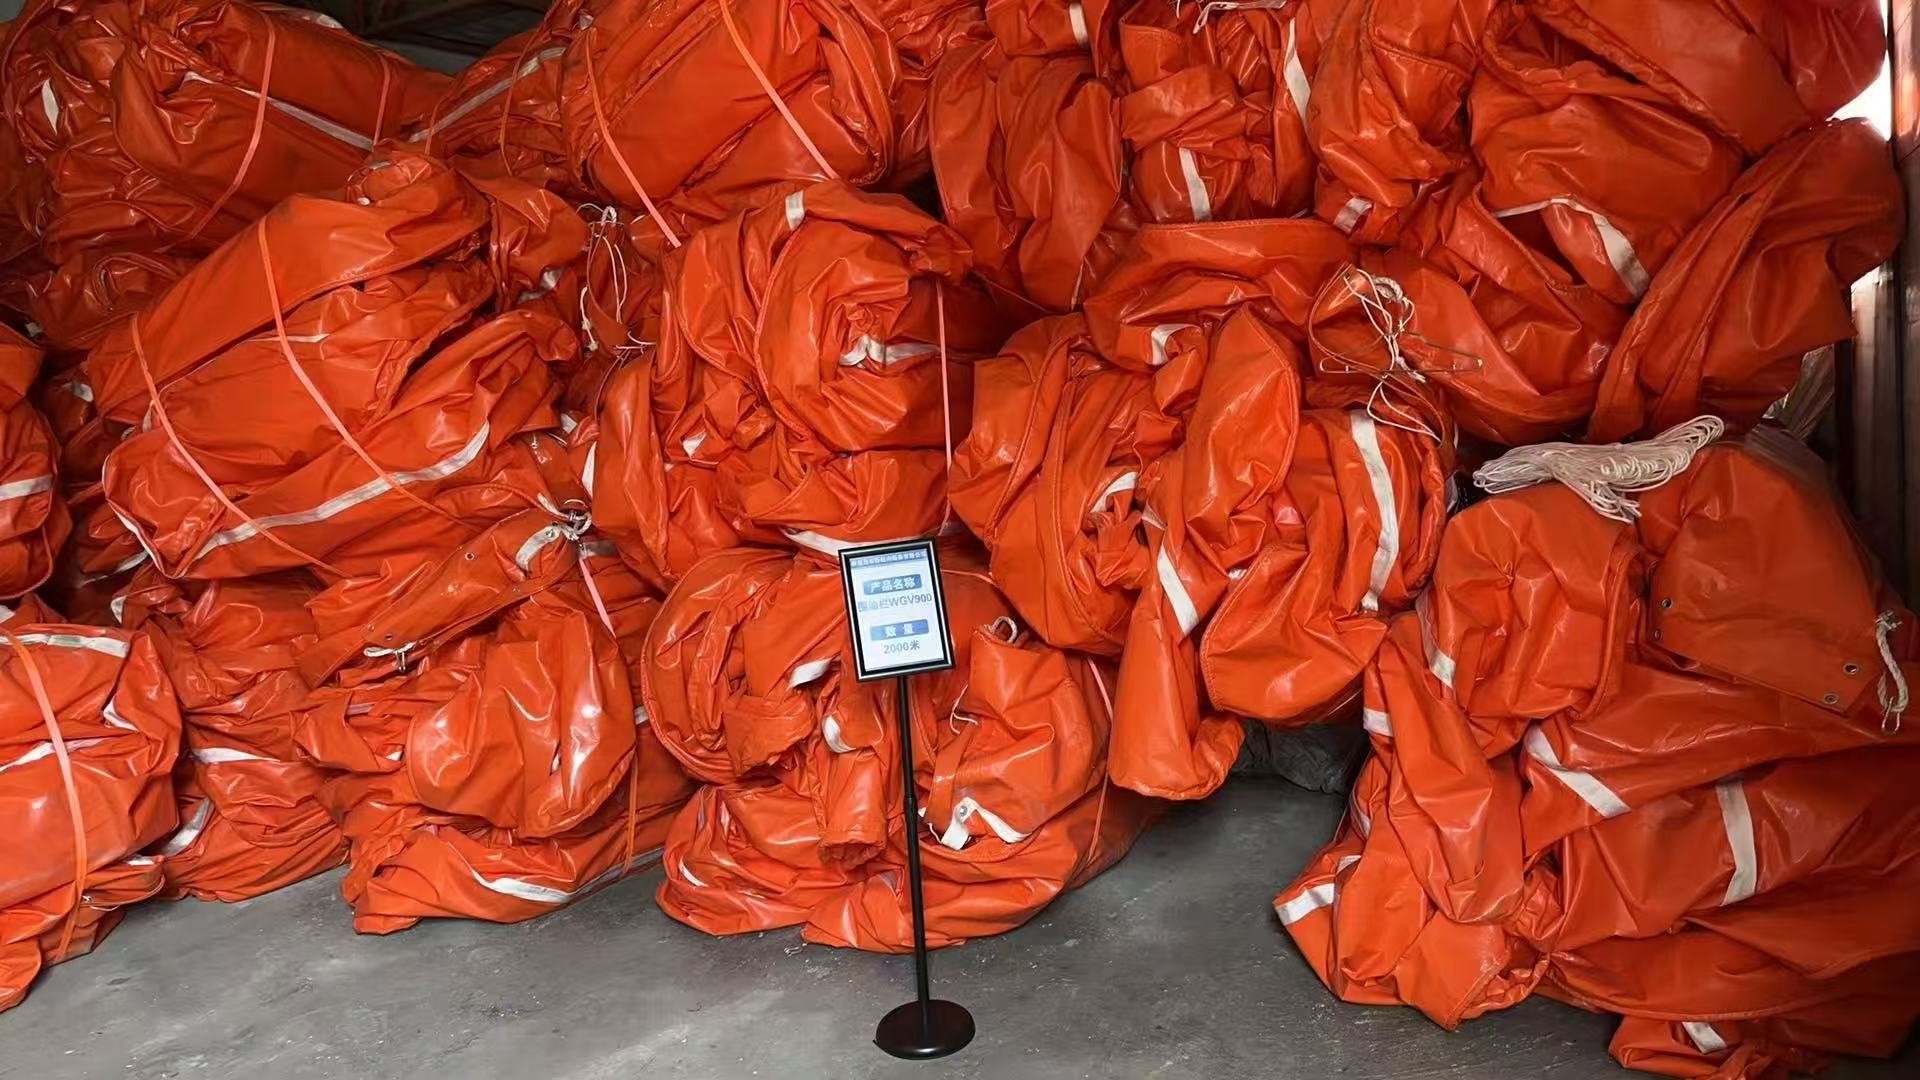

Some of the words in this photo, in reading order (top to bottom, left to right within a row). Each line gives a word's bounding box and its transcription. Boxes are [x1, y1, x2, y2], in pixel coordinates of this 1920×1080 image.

[870, 577, 916, 593] 产品名称
[883, 640, 920, 654] 2000米
